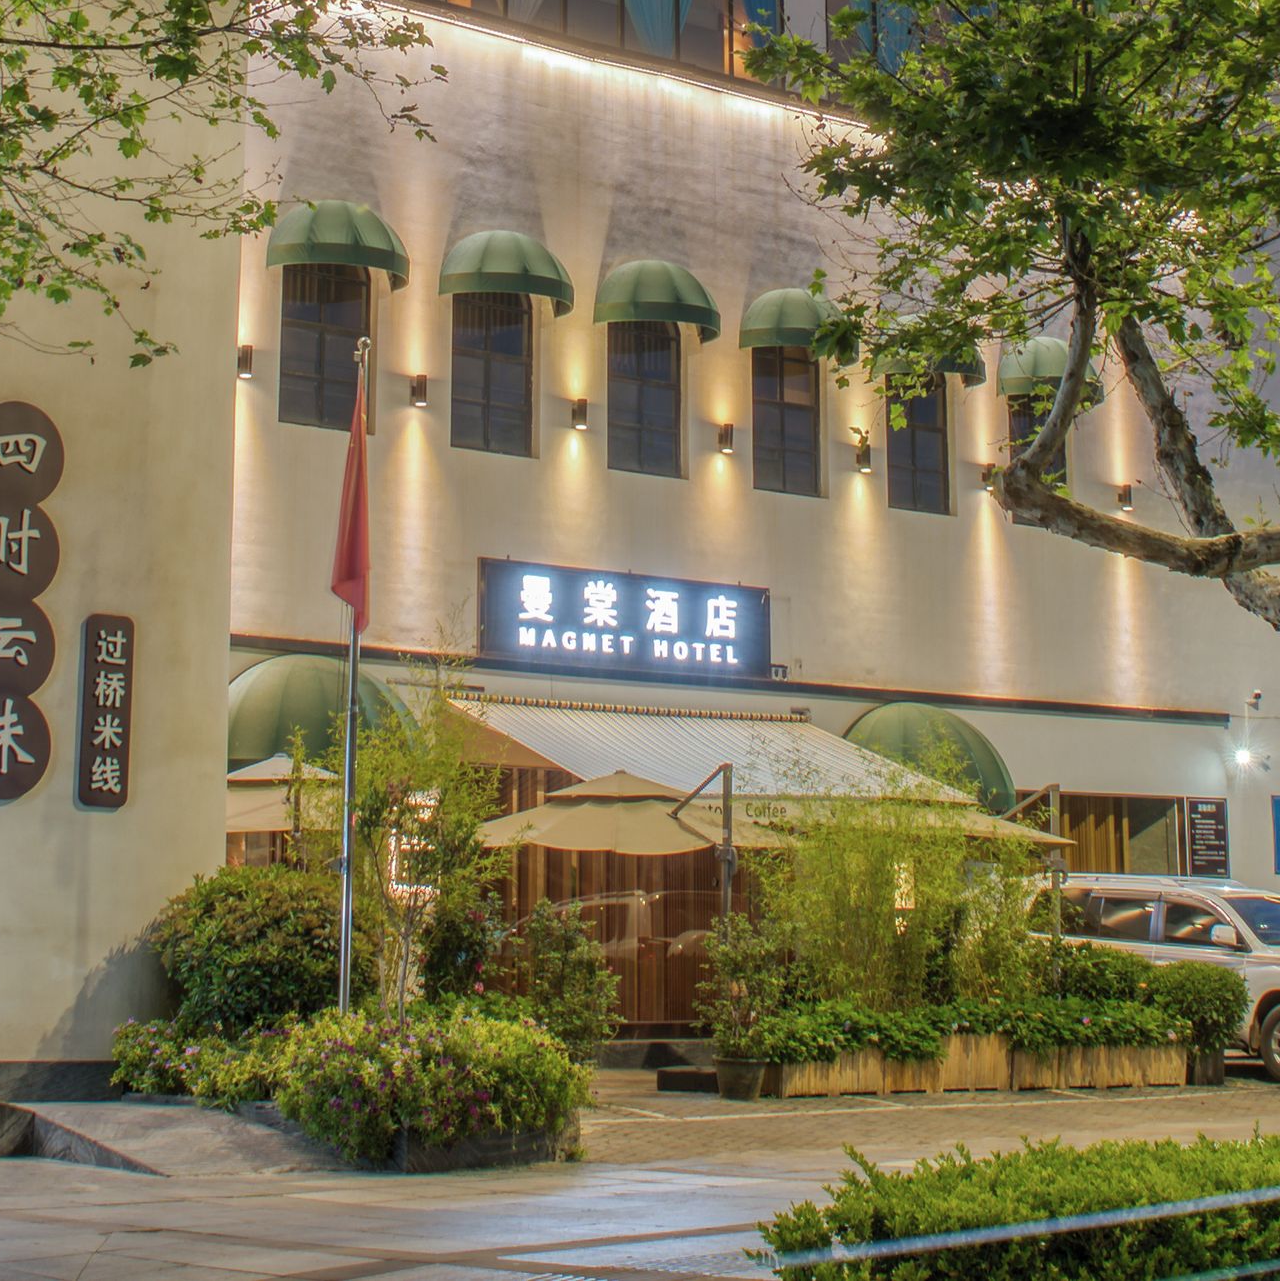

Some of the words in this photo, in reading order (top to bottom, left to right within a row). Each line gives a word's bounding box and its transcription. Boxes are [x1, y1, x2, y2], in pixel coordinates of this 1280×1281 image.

[518, 574, 738, 640] 曼棠酒店
[518, 626, 634, 655] MAGNET
[652, 638, 739, 665] HOTEL
[90, 630, 127, 794] 过桥米线
[745, 802, 787, 818] Coffee
